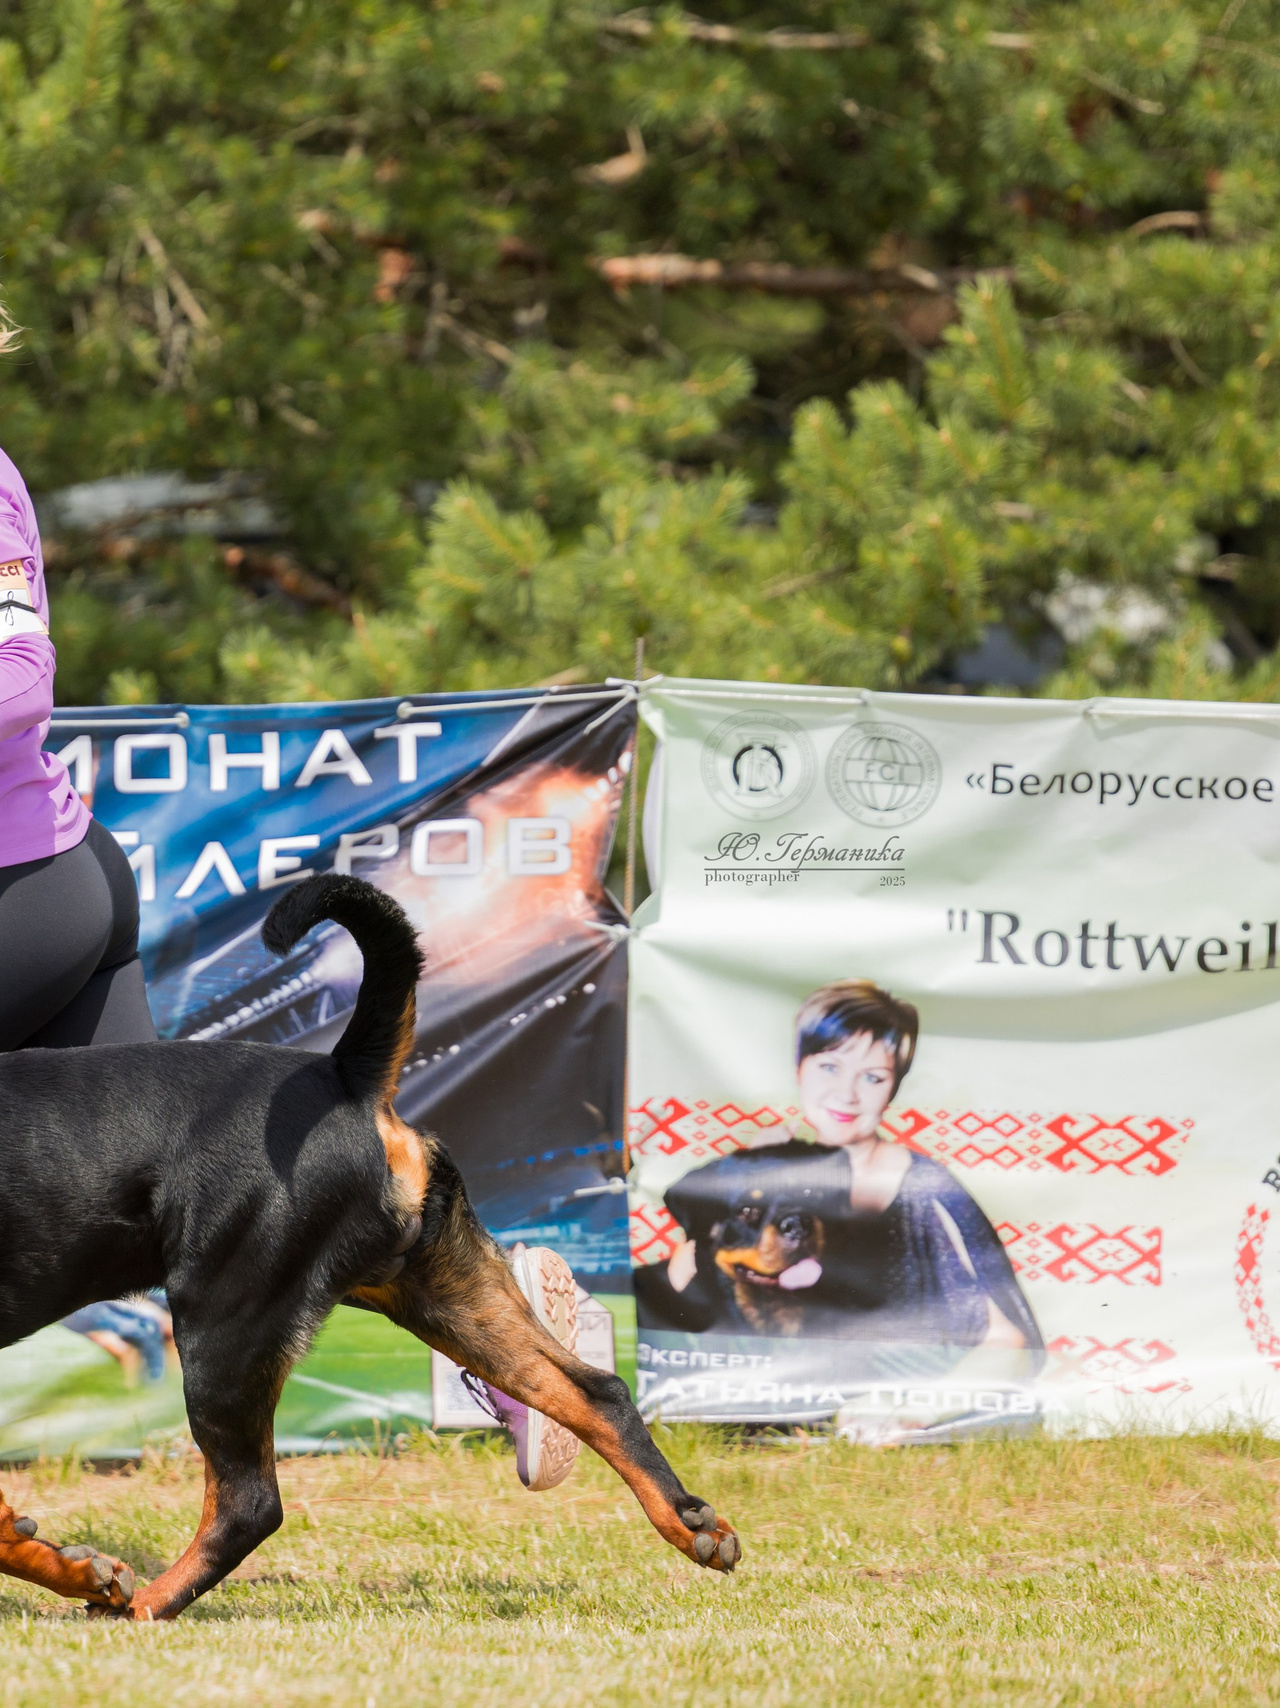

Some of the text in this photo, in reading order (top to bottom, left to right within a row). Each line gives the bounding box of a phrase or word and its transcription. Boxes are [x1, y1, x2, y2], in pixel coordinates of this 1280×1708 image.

[864, 763, 905, 784] FCI
[966, 763, 1274, 806] «Белорусское
[948, 909, 1280, 976] "Rottweil
